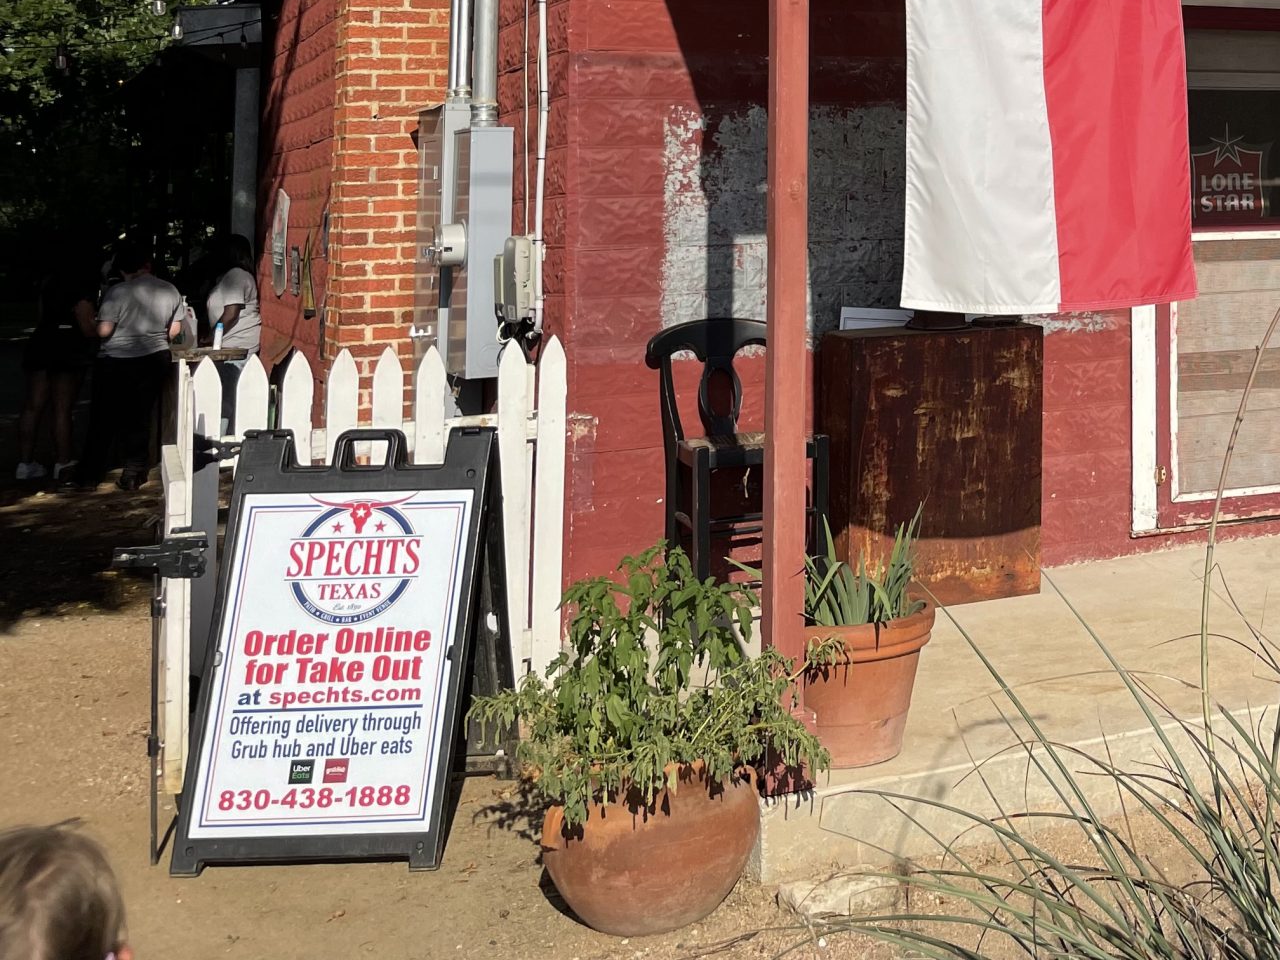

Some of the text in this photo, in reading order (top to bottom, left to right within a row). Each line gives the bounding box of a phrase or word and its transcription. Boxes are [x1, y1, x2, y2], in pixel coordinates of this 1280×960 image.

[1200, 193, 1255, 212] STAR
[286, 538, 421, 577] SPECHTS
[318, 582, 382, 600] TEXAS
[243, 627, 431, 656] Order Online
[245, 655, 423, 685] for Take Out
[238, 686, 421, 709] at spechts.com
[229, 711, 421, 738] Offering delivery through
[231, 736, 413, 759] Grub hub and Uber eats
[291, 772, 310, 780] Eats
[292, 764, 311, 772] Uber
[218, 785, 411, 811] 830-438-1888
